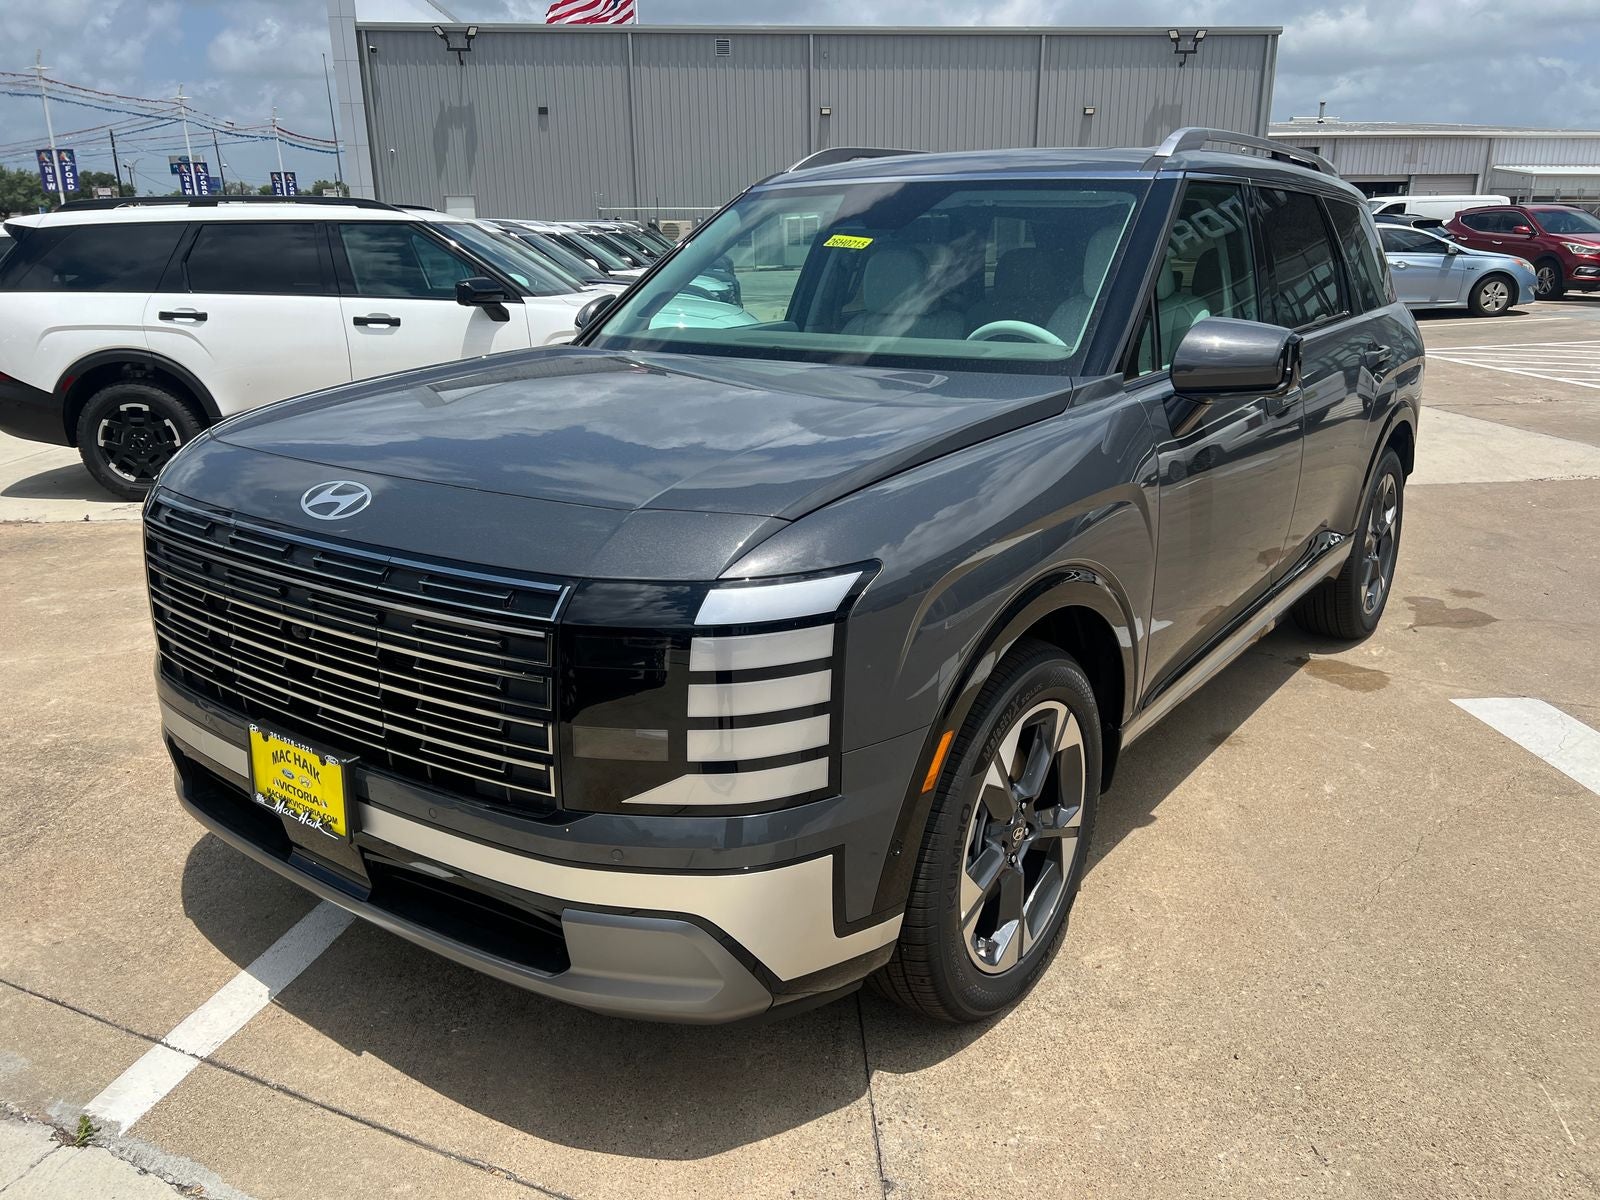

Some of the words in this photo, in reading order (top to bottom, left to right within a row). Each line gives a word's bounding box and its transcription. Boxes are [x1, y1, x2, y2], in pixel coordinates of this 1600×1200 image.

[44, 166, 56, 190] NEW
[64, 165, 75, 190] FORD
[183, 176, 192, 195] NEW
[200, 175, 208, 195] FORD
[272, 749, 292, 765] MAC
[293, 752, 321, 785] HAIK
[278, 779, 320, 806] VICTORIA
[273, 799, 298, 820] Mac
[298, 812, 330, 834] Haik
